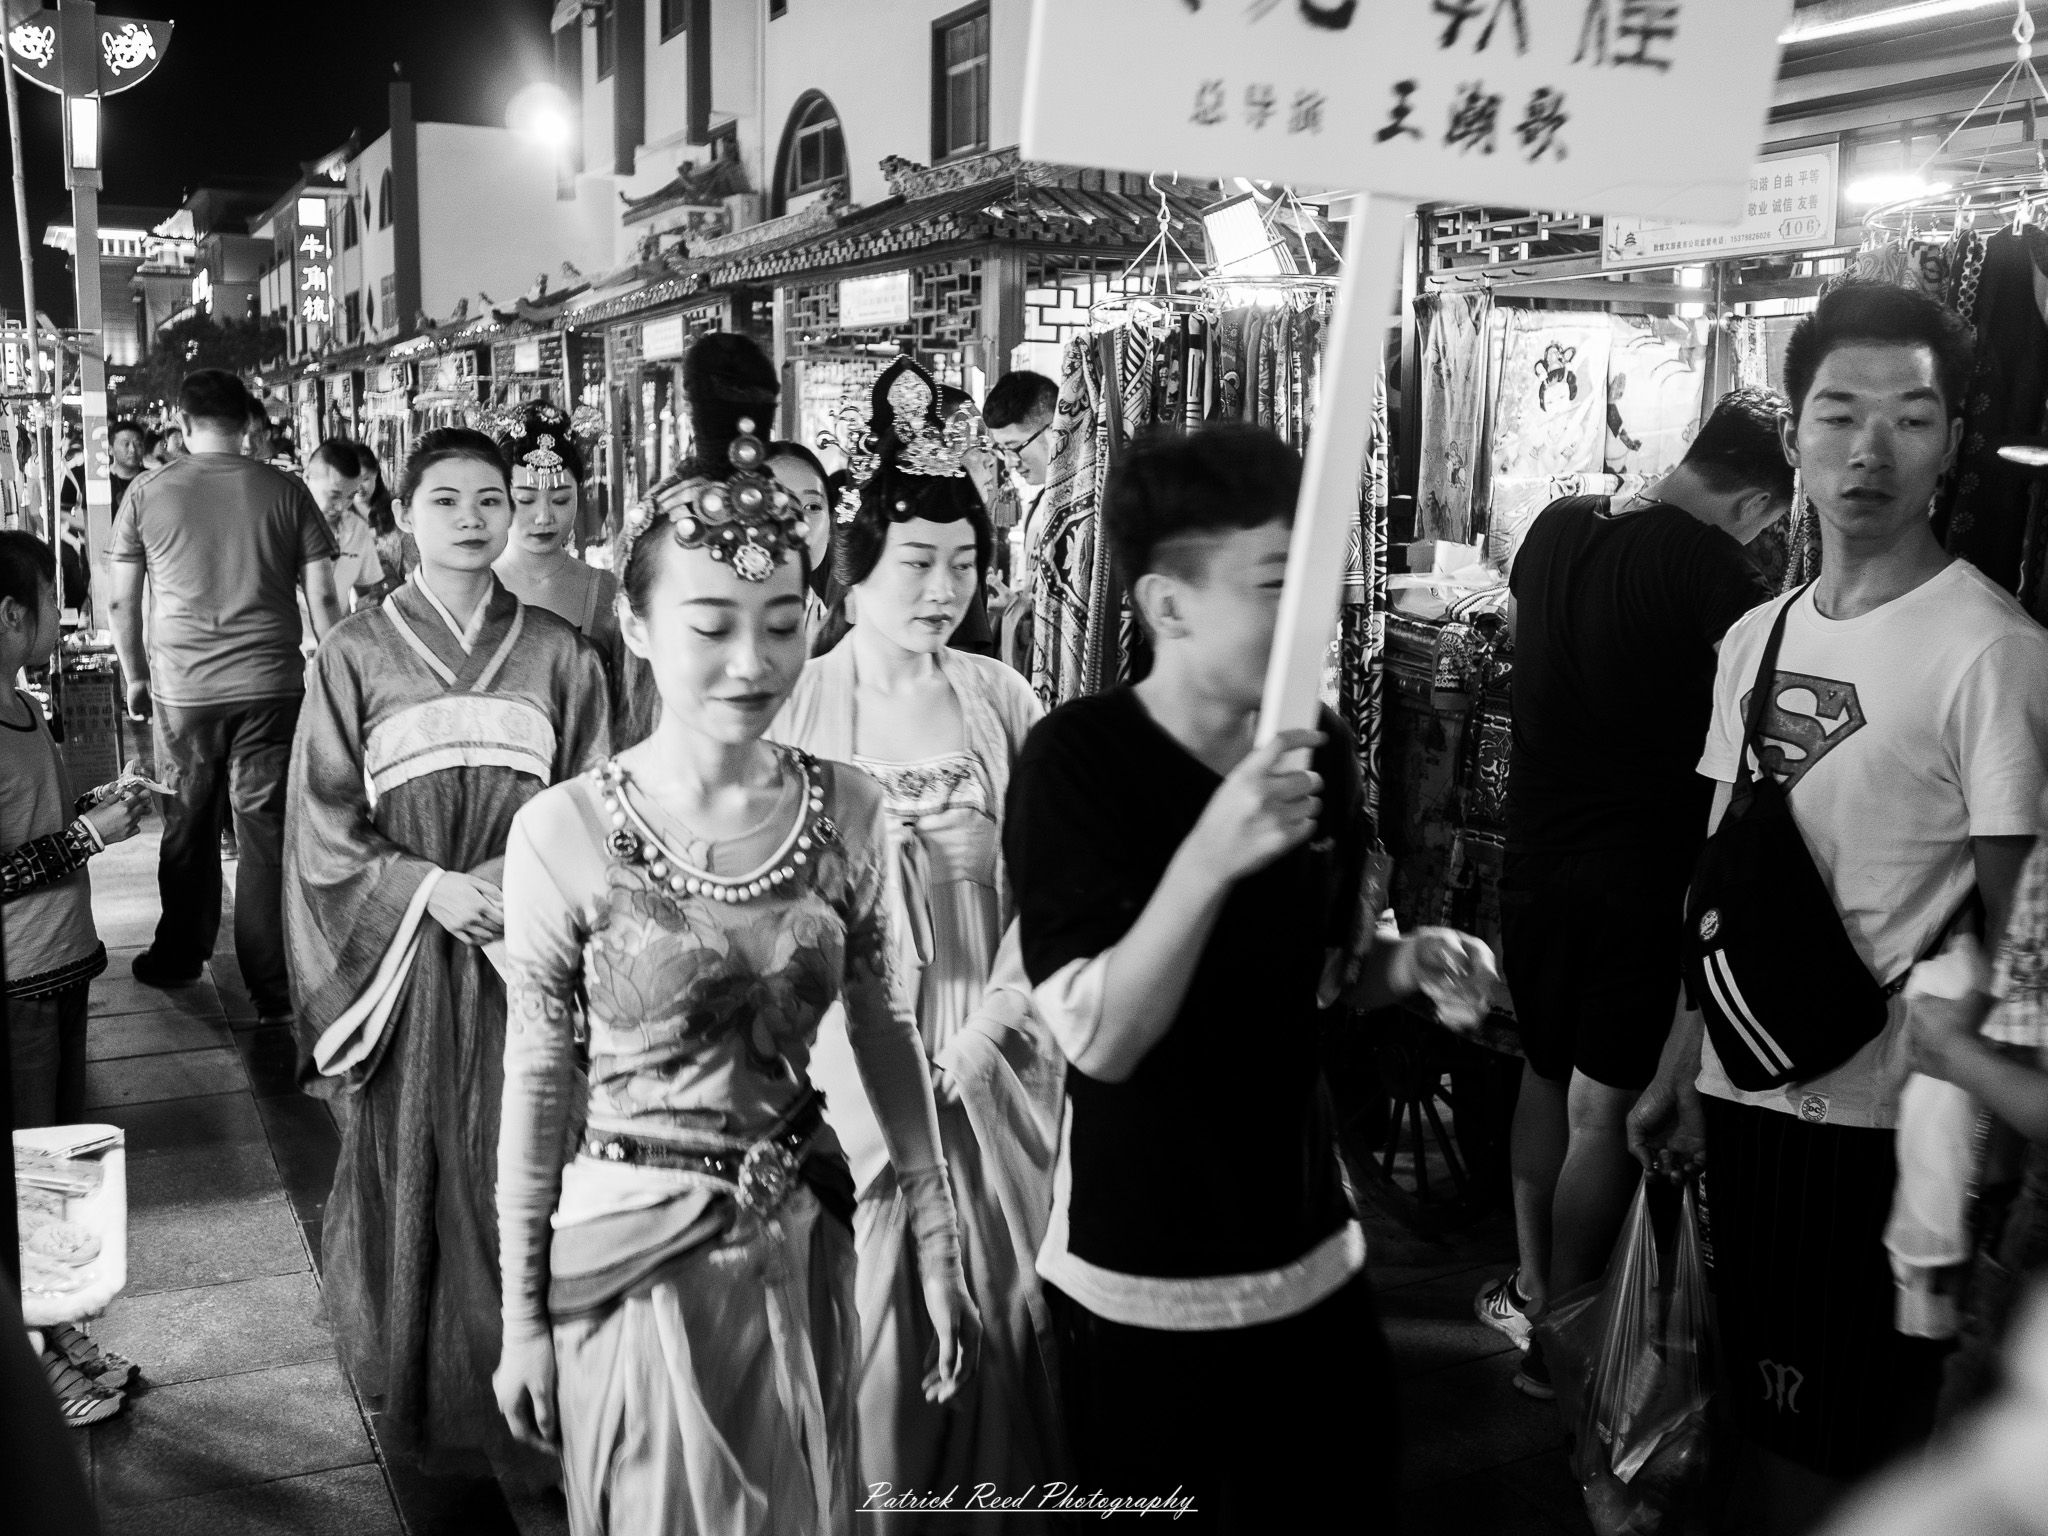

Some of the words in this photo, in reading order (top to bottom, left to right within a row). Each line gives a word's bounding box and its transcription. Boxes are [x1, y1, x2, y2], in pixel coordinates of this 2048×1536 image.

[1774, 172, 1794, 190] 自由
[1798, 168, 1820, 187] 平等
[1747, 201, 1768, 217] 敬业
[1772, 197, 1793, 214] 诚信
[1797, 193, 1819, 211] 友善
[1785, 218, 1815, 237] 106
[298, 233, 330, 323] 牛角梳
